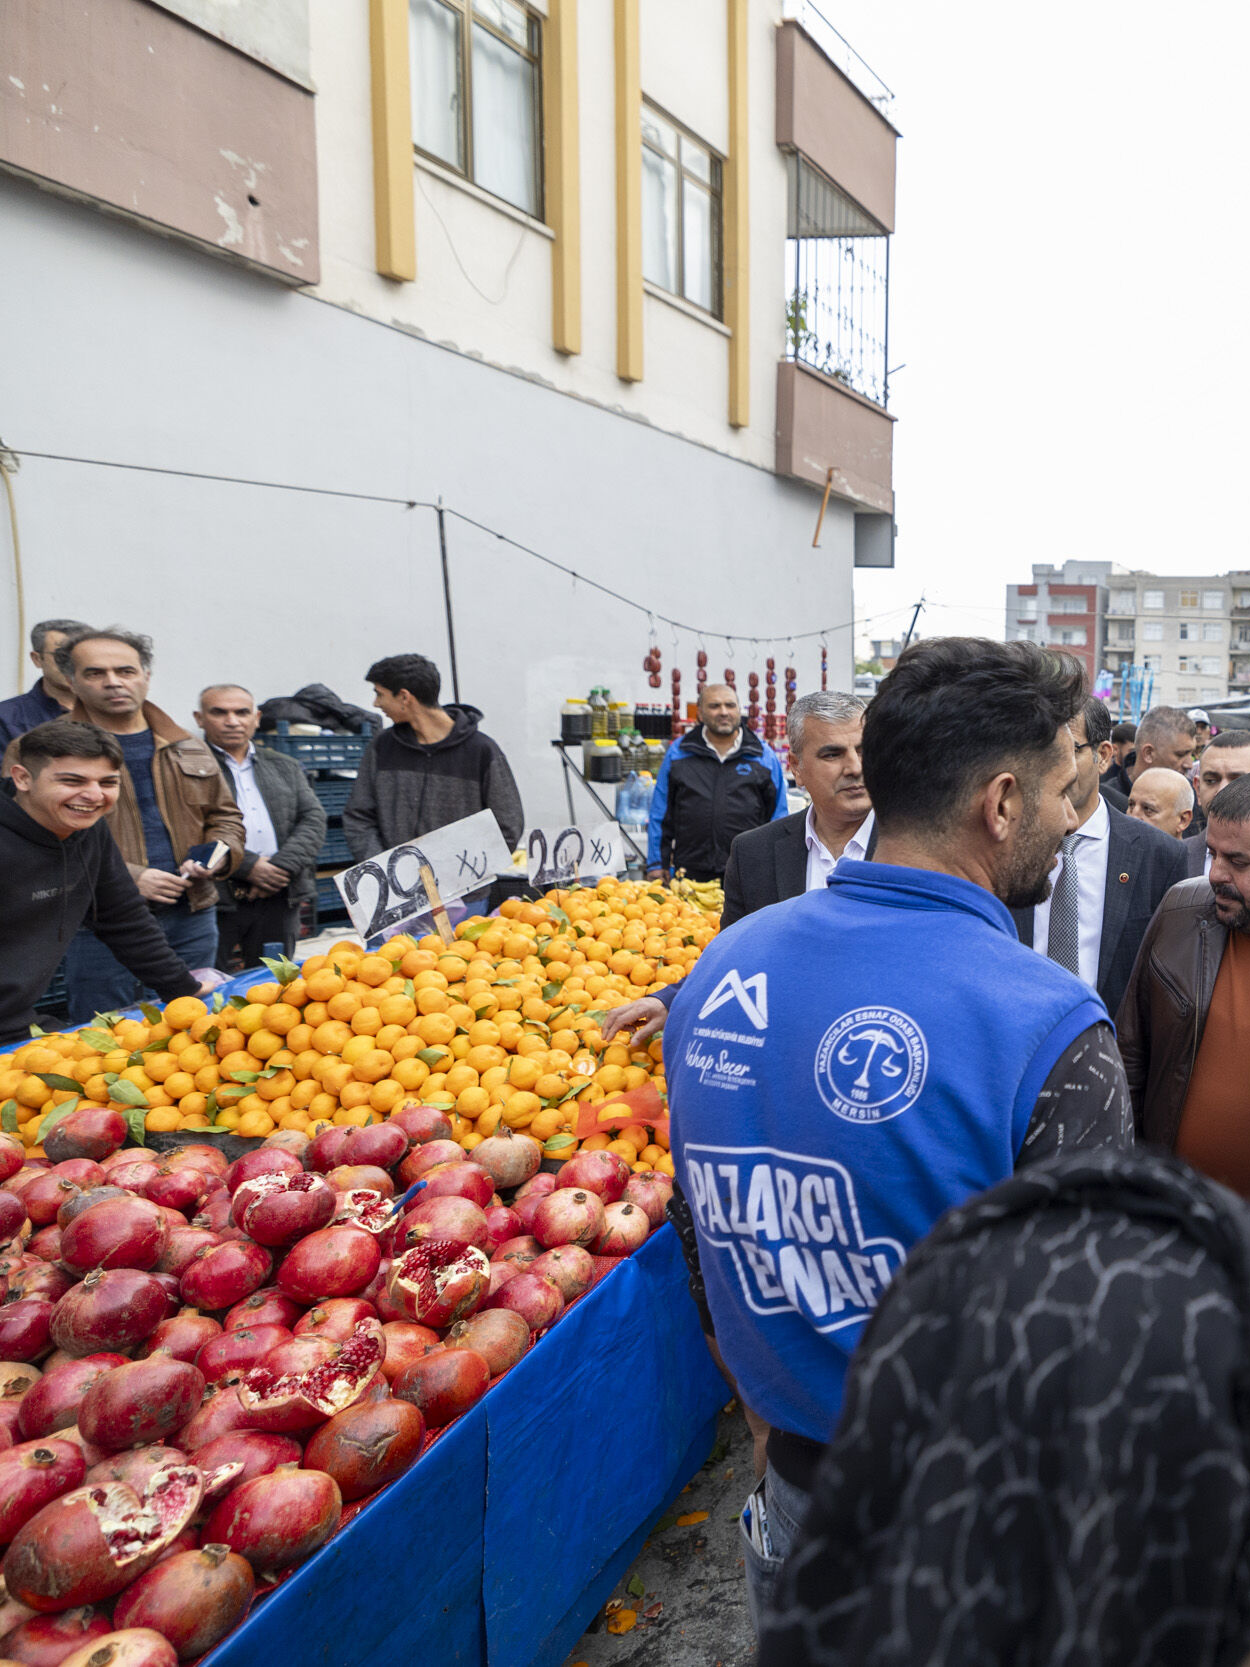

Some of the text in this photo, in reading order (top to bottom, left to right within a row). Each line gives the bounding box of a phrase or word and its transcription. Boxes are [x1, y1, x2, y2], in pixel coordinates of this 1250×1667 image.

[528, 827, 584, 887] 20
[855, 1010, 889, 1021] ESNAF
[888, 1014, 915, 1037] ODASI
[687, 1159, 849, 1246] PAZARCI
